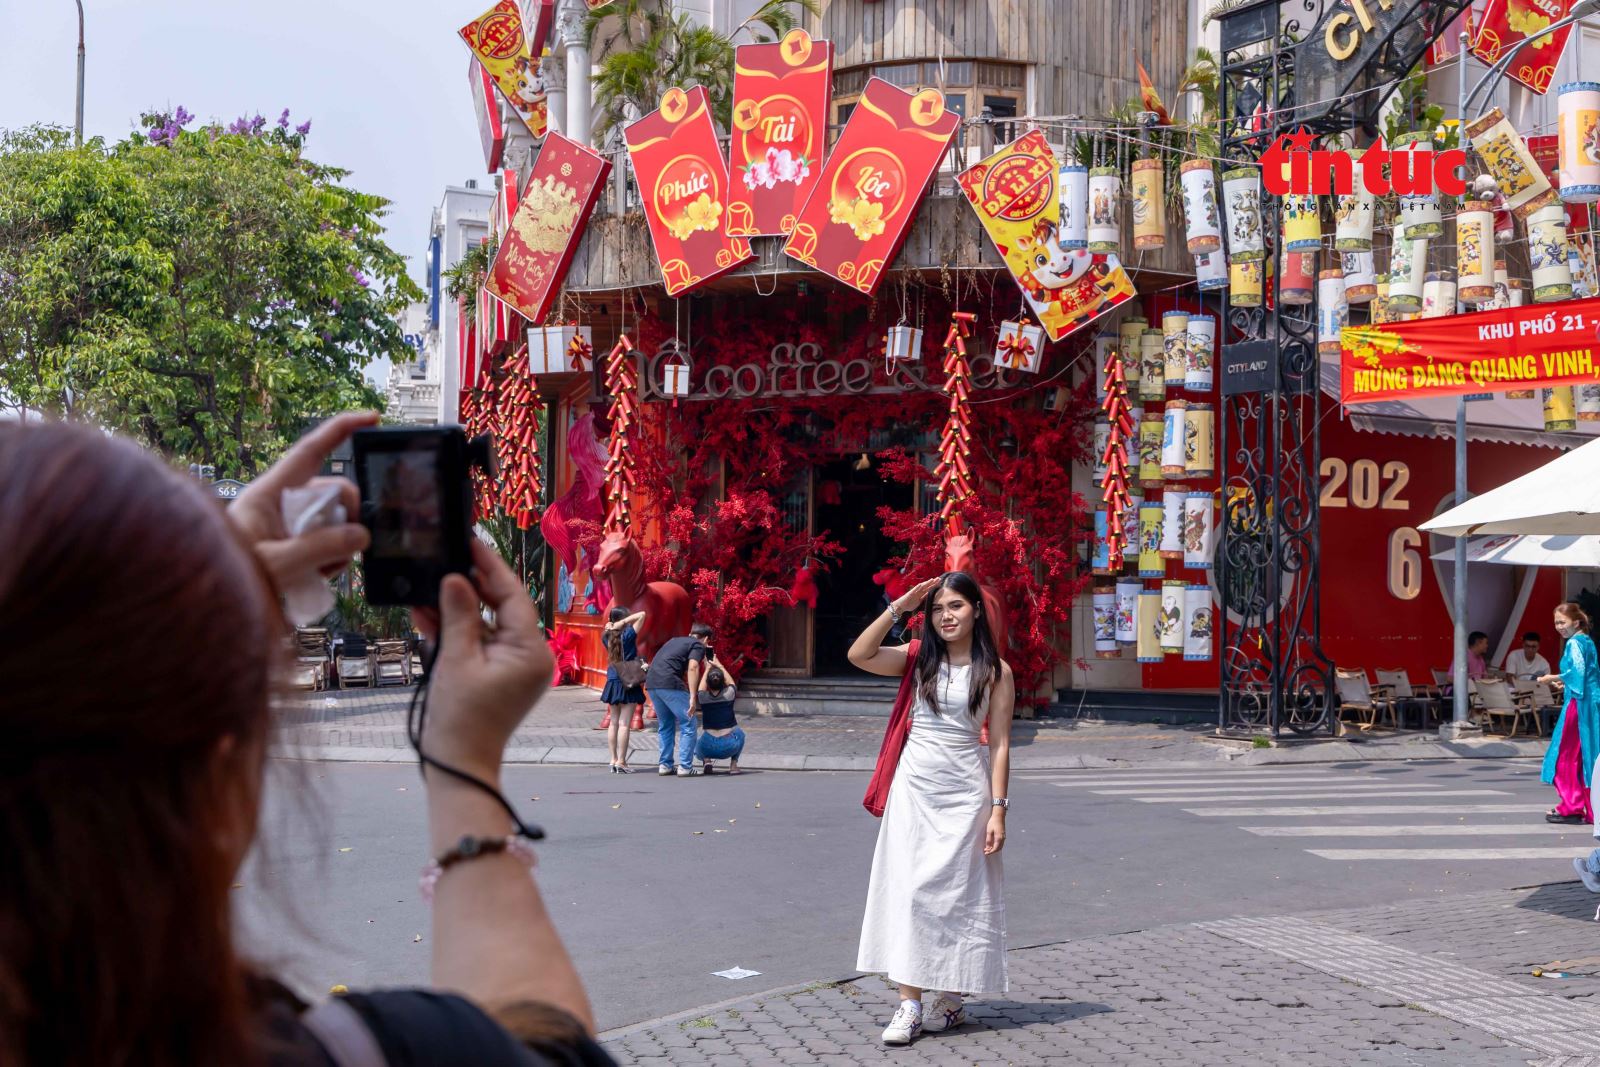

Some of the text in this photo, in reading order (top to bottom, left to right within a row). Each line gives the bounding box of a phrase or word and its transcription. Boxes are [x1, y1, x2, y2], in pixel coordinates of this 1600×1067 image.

[1325, 0, 1393, 60] CI
[760, 115, 796, 144] Tài
[660, 171, 709, 205] Phúc
[1479, 325, 1514, 341] KHU
[1520, 311, 1557, 336] PHỐ
[1562, 314, 1585, 332] 21
[705, 342, 873, 399] coffee
[1227, 360, 1268, 375] CITYLAND
[1354, 349, 1600, 394] MỪNG ĐẢNG QUANG VINH,
[230, 487, 237, 497] 5
[1318, 457, 1411, 511] 202
[1387, 526, 1422, 601] 6
